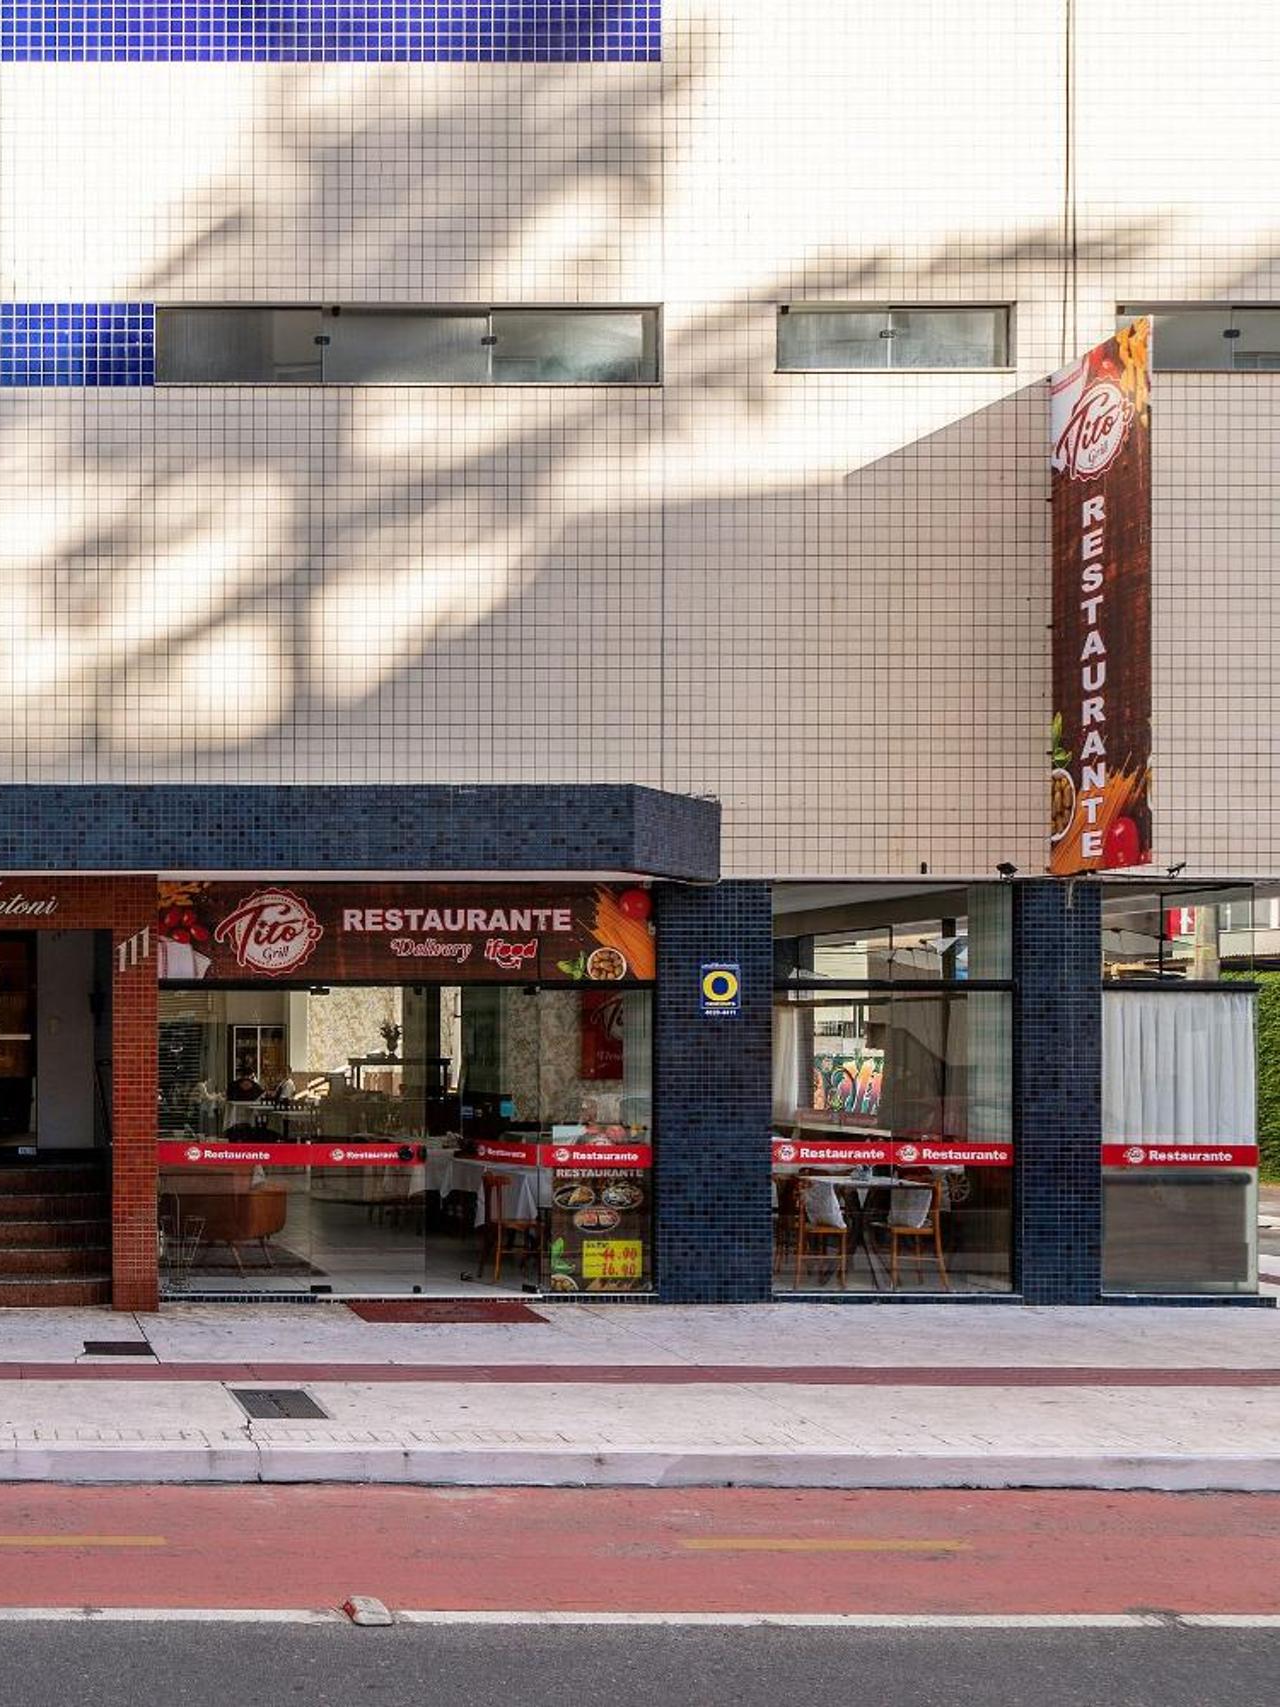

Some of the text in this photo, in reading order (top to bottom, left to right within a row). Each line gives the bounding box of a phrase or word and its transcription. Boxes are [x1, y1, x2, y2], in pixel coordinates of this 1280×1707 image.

[1080, 494, 1107, 859] RESTAURANTE
[342, 908, 572, 932] RESTAURANTE
[215, 902, 324, 967] Tito's
[262, 945, 290, 961] Grill
[389, 938, 473, 964] Delivery
[203, 1149, 271, 1161] Restaurante
[346, 1150, 400, 1160] Restaurant
[572, 1151, 640, 1162] Restaurante
[799, 1147, 885, 1160] Restaurante
[922, 1148, 1008, 1161] Restaurante
[1148, 1149, 1234, 1162] Restaurante
[555, 1168, 644, 1178] RESTAURANTE
